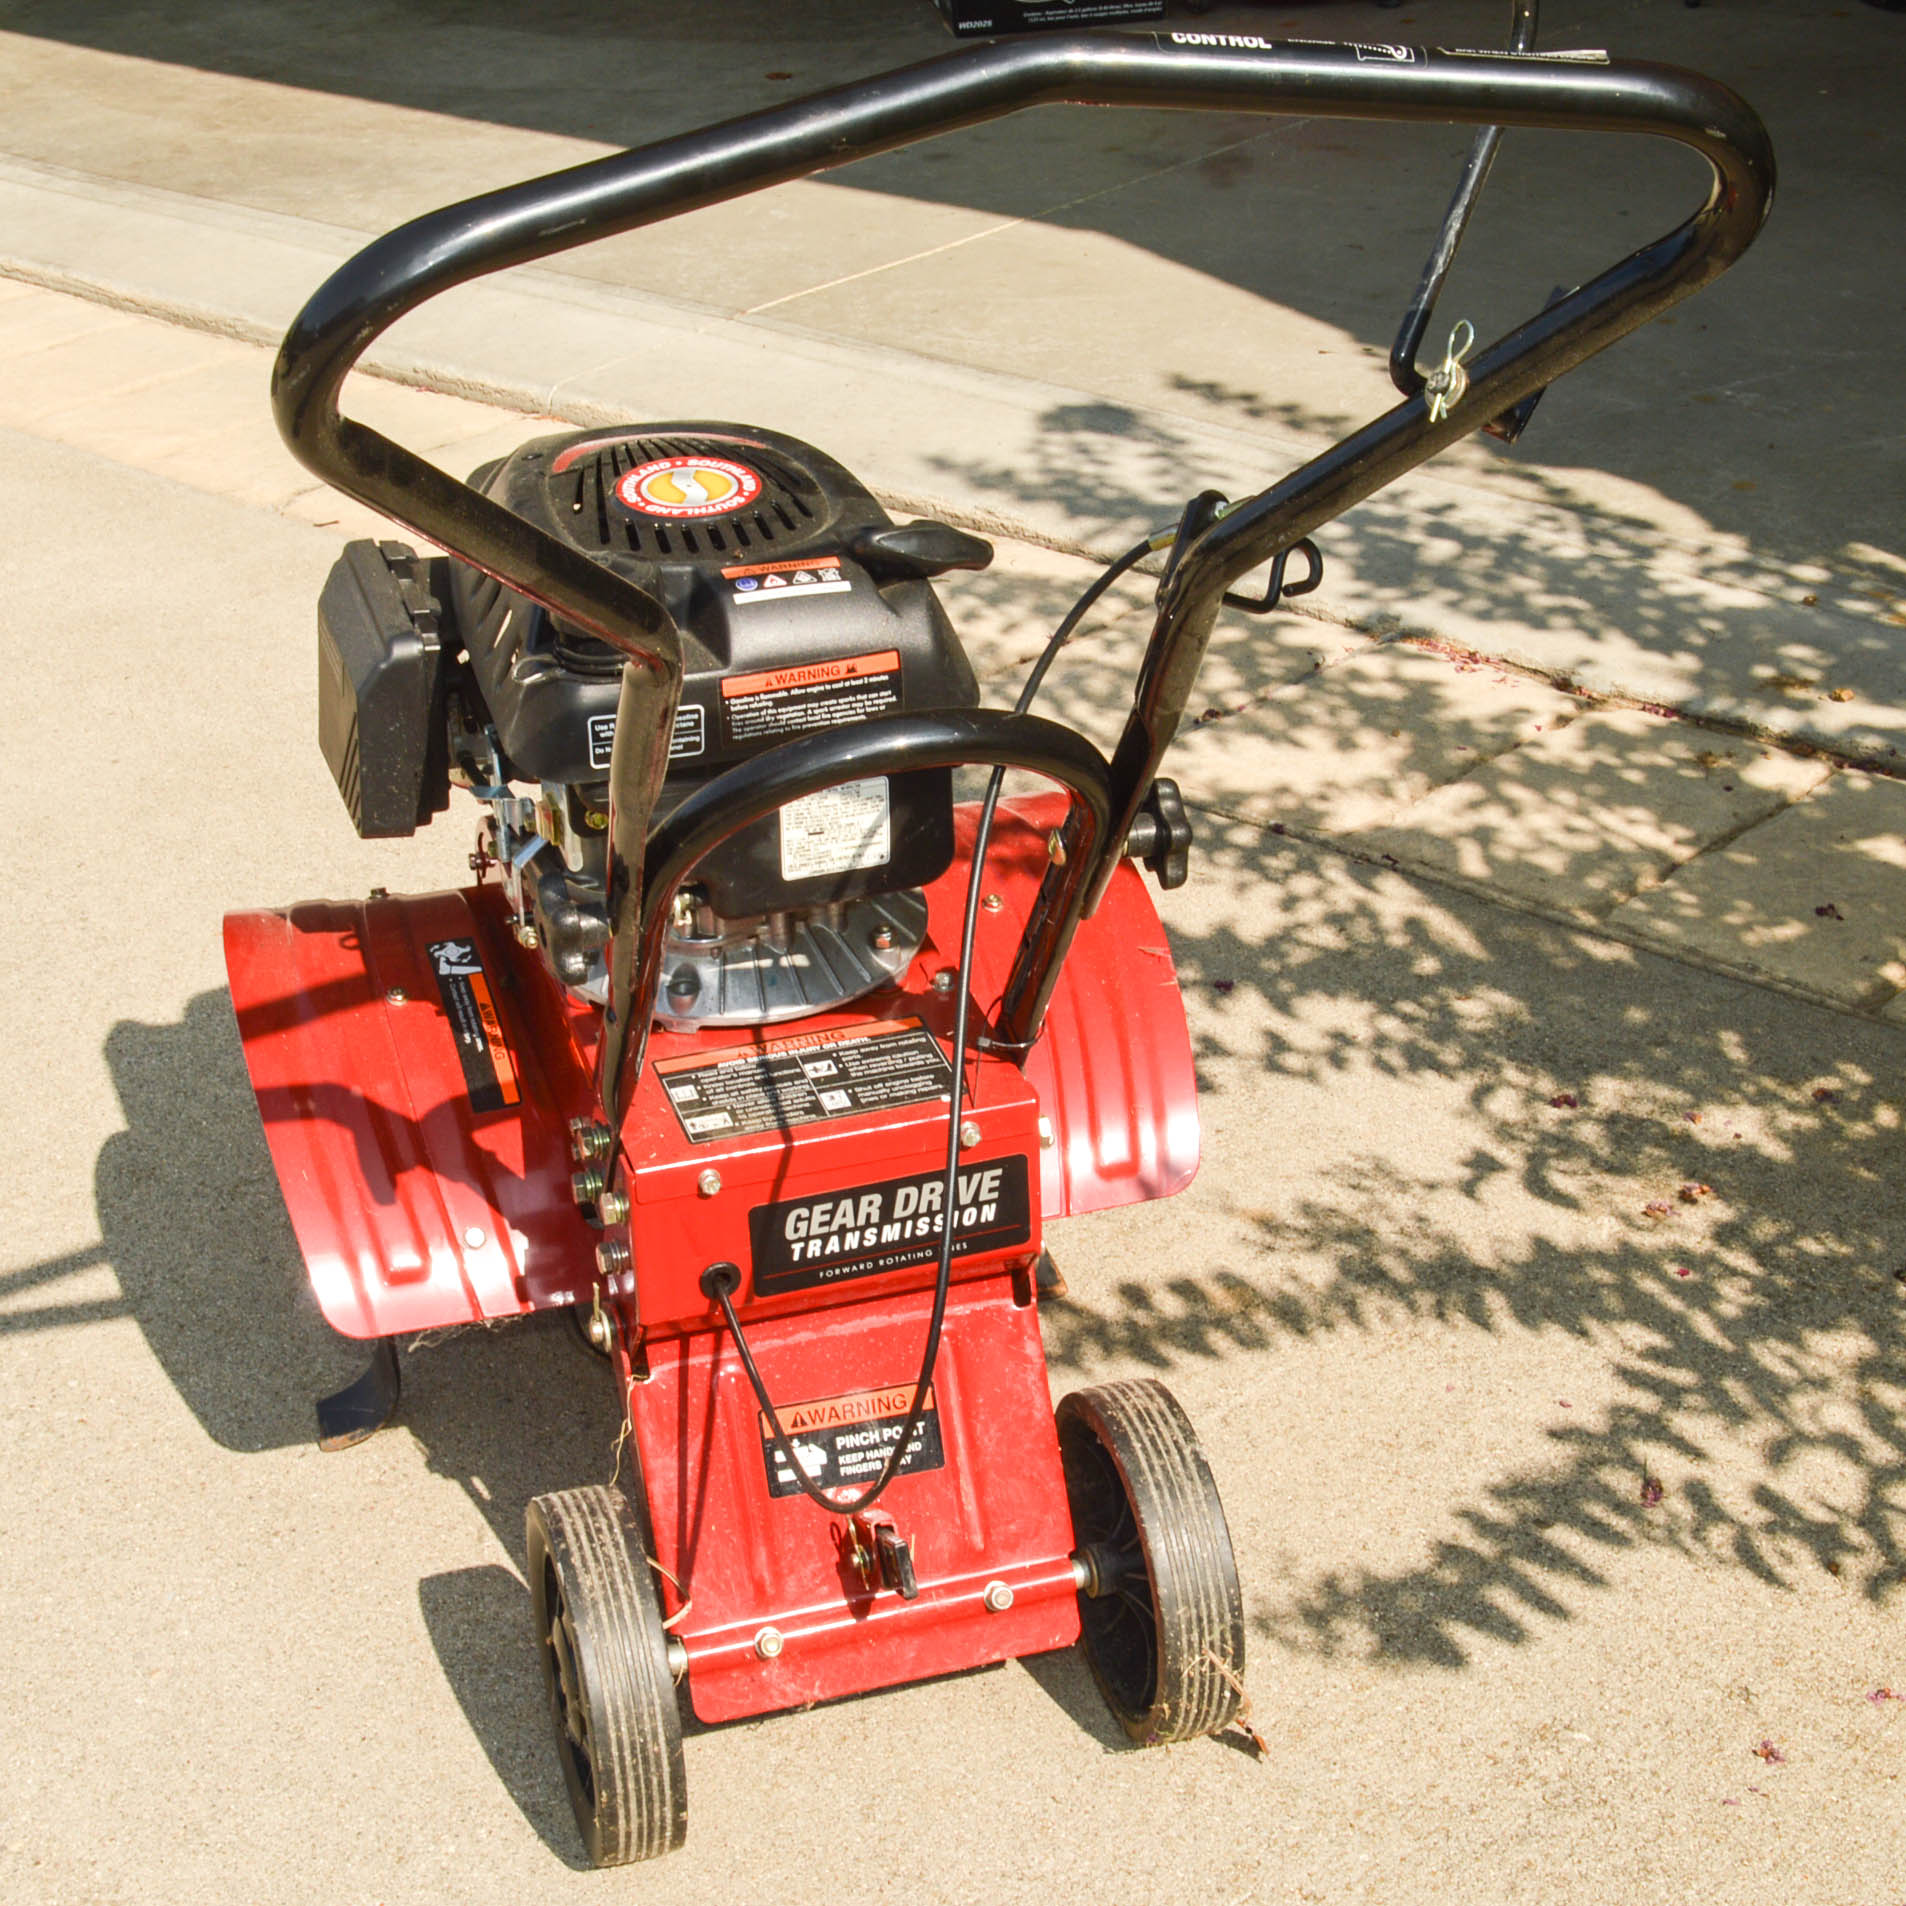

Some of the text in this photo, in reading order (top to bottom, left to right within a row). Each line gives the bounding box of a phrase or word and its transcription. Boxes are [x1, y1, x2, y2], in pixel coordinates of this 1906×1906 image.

[622, 461, 671, 504] SOUTHLAND
[687, 458, 756, 492] SOUTHLAND
[645, 496, 746, 515] SOUTHLAND
[774, 664, 841, 684] WARNING
[481, 1009, 506, 1060] WARNING
[753, 1031, 845, 1056] WARNING
[785, 1168, 1003, 1241] GEAR DRVE
[791, 1203, 997, 1262] TRANSMISSION
[819, 1249, 933, 1279] FORWARD ROTATING
[808, 1393, 908, 1425] WARNING
[836, 1421, 925, 1450] PINCH POT
[838, 1452, 864, 1465] KEEP
[866, 1447, 896, 1460] HAND
[840, 1461, 882, 1477] FINGERS
